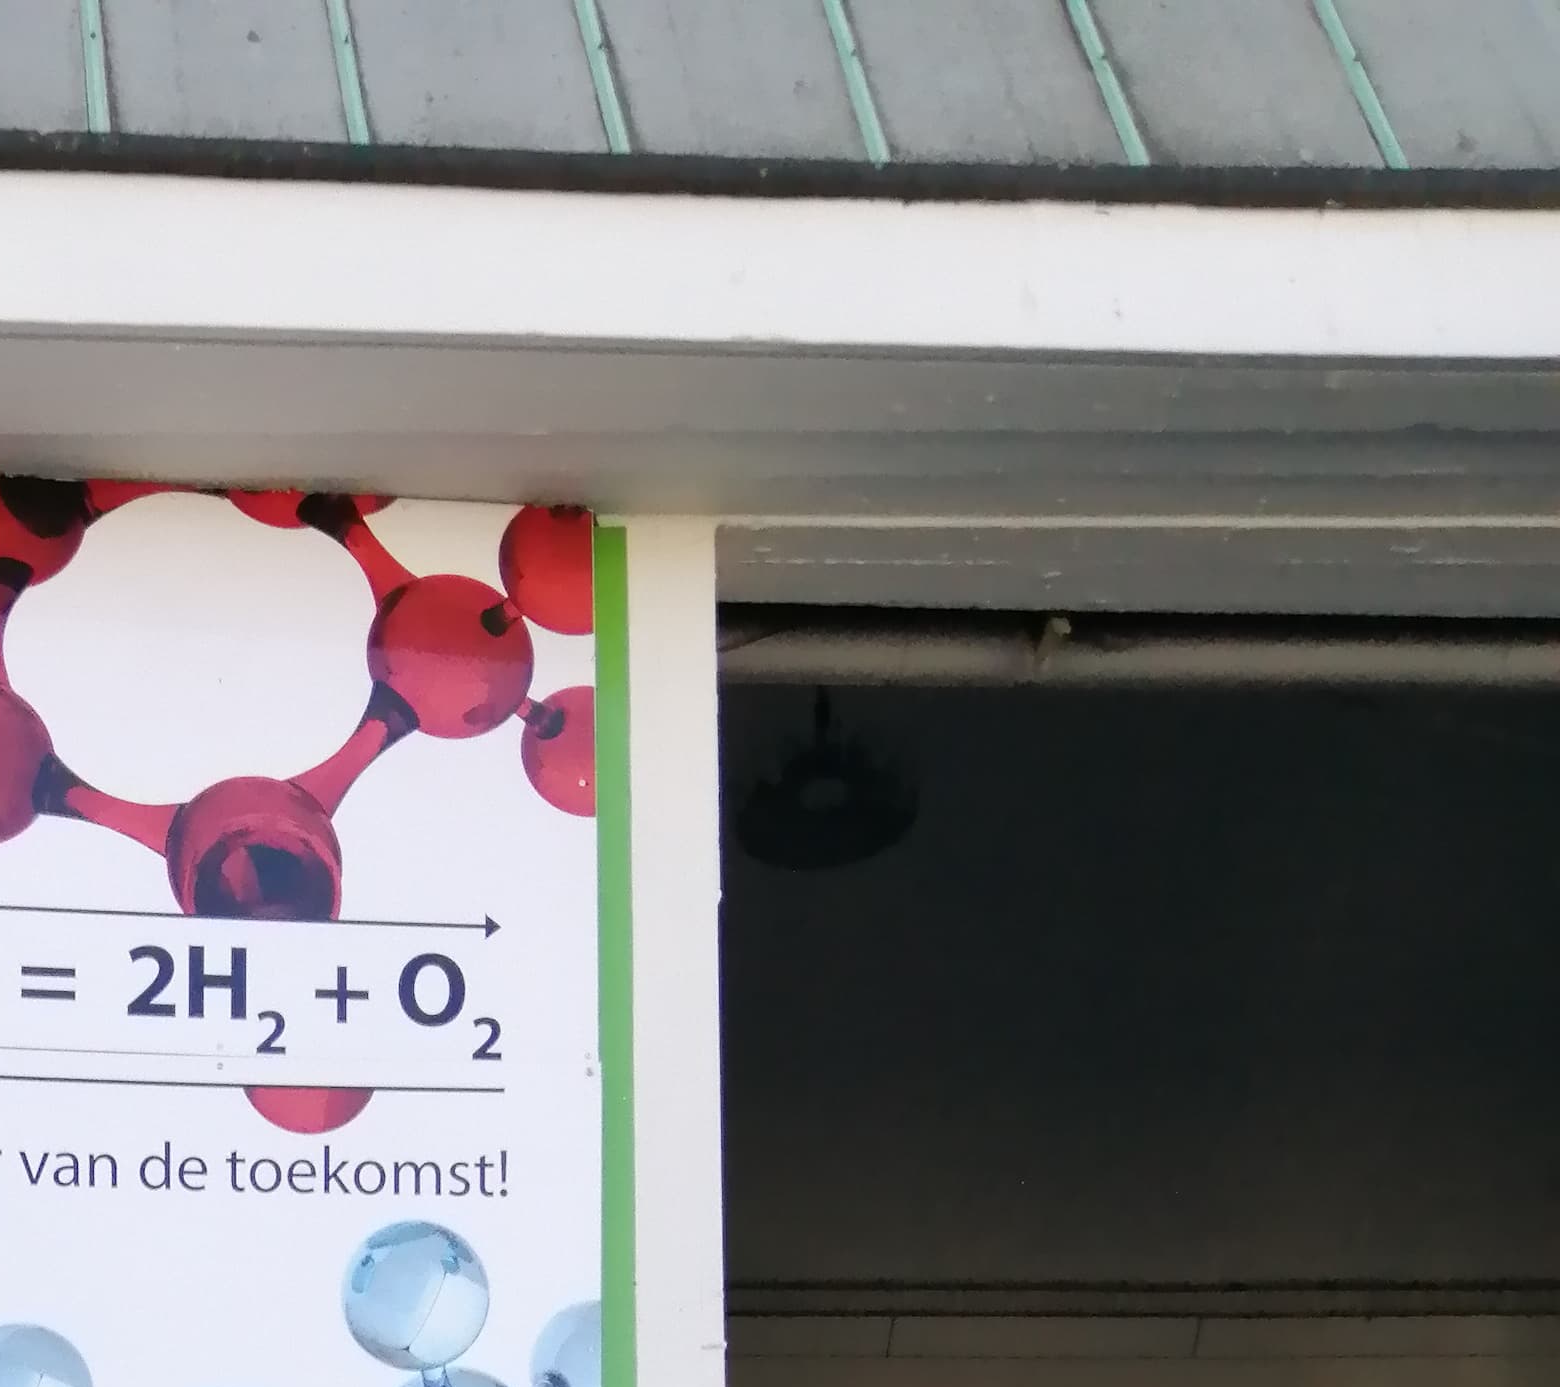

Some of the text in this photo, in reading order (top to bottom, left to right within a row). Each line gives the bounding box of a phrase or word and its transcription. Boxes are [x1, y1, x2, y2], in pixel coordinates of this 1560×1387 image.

[21, 966, 76, 1001] =
[315, 966, 369, 1023] +
[19, 1151, 118, 1187] van
[139, 1141, 208, 1191] de
[225, 1145, 507, 1196] toekomst!
